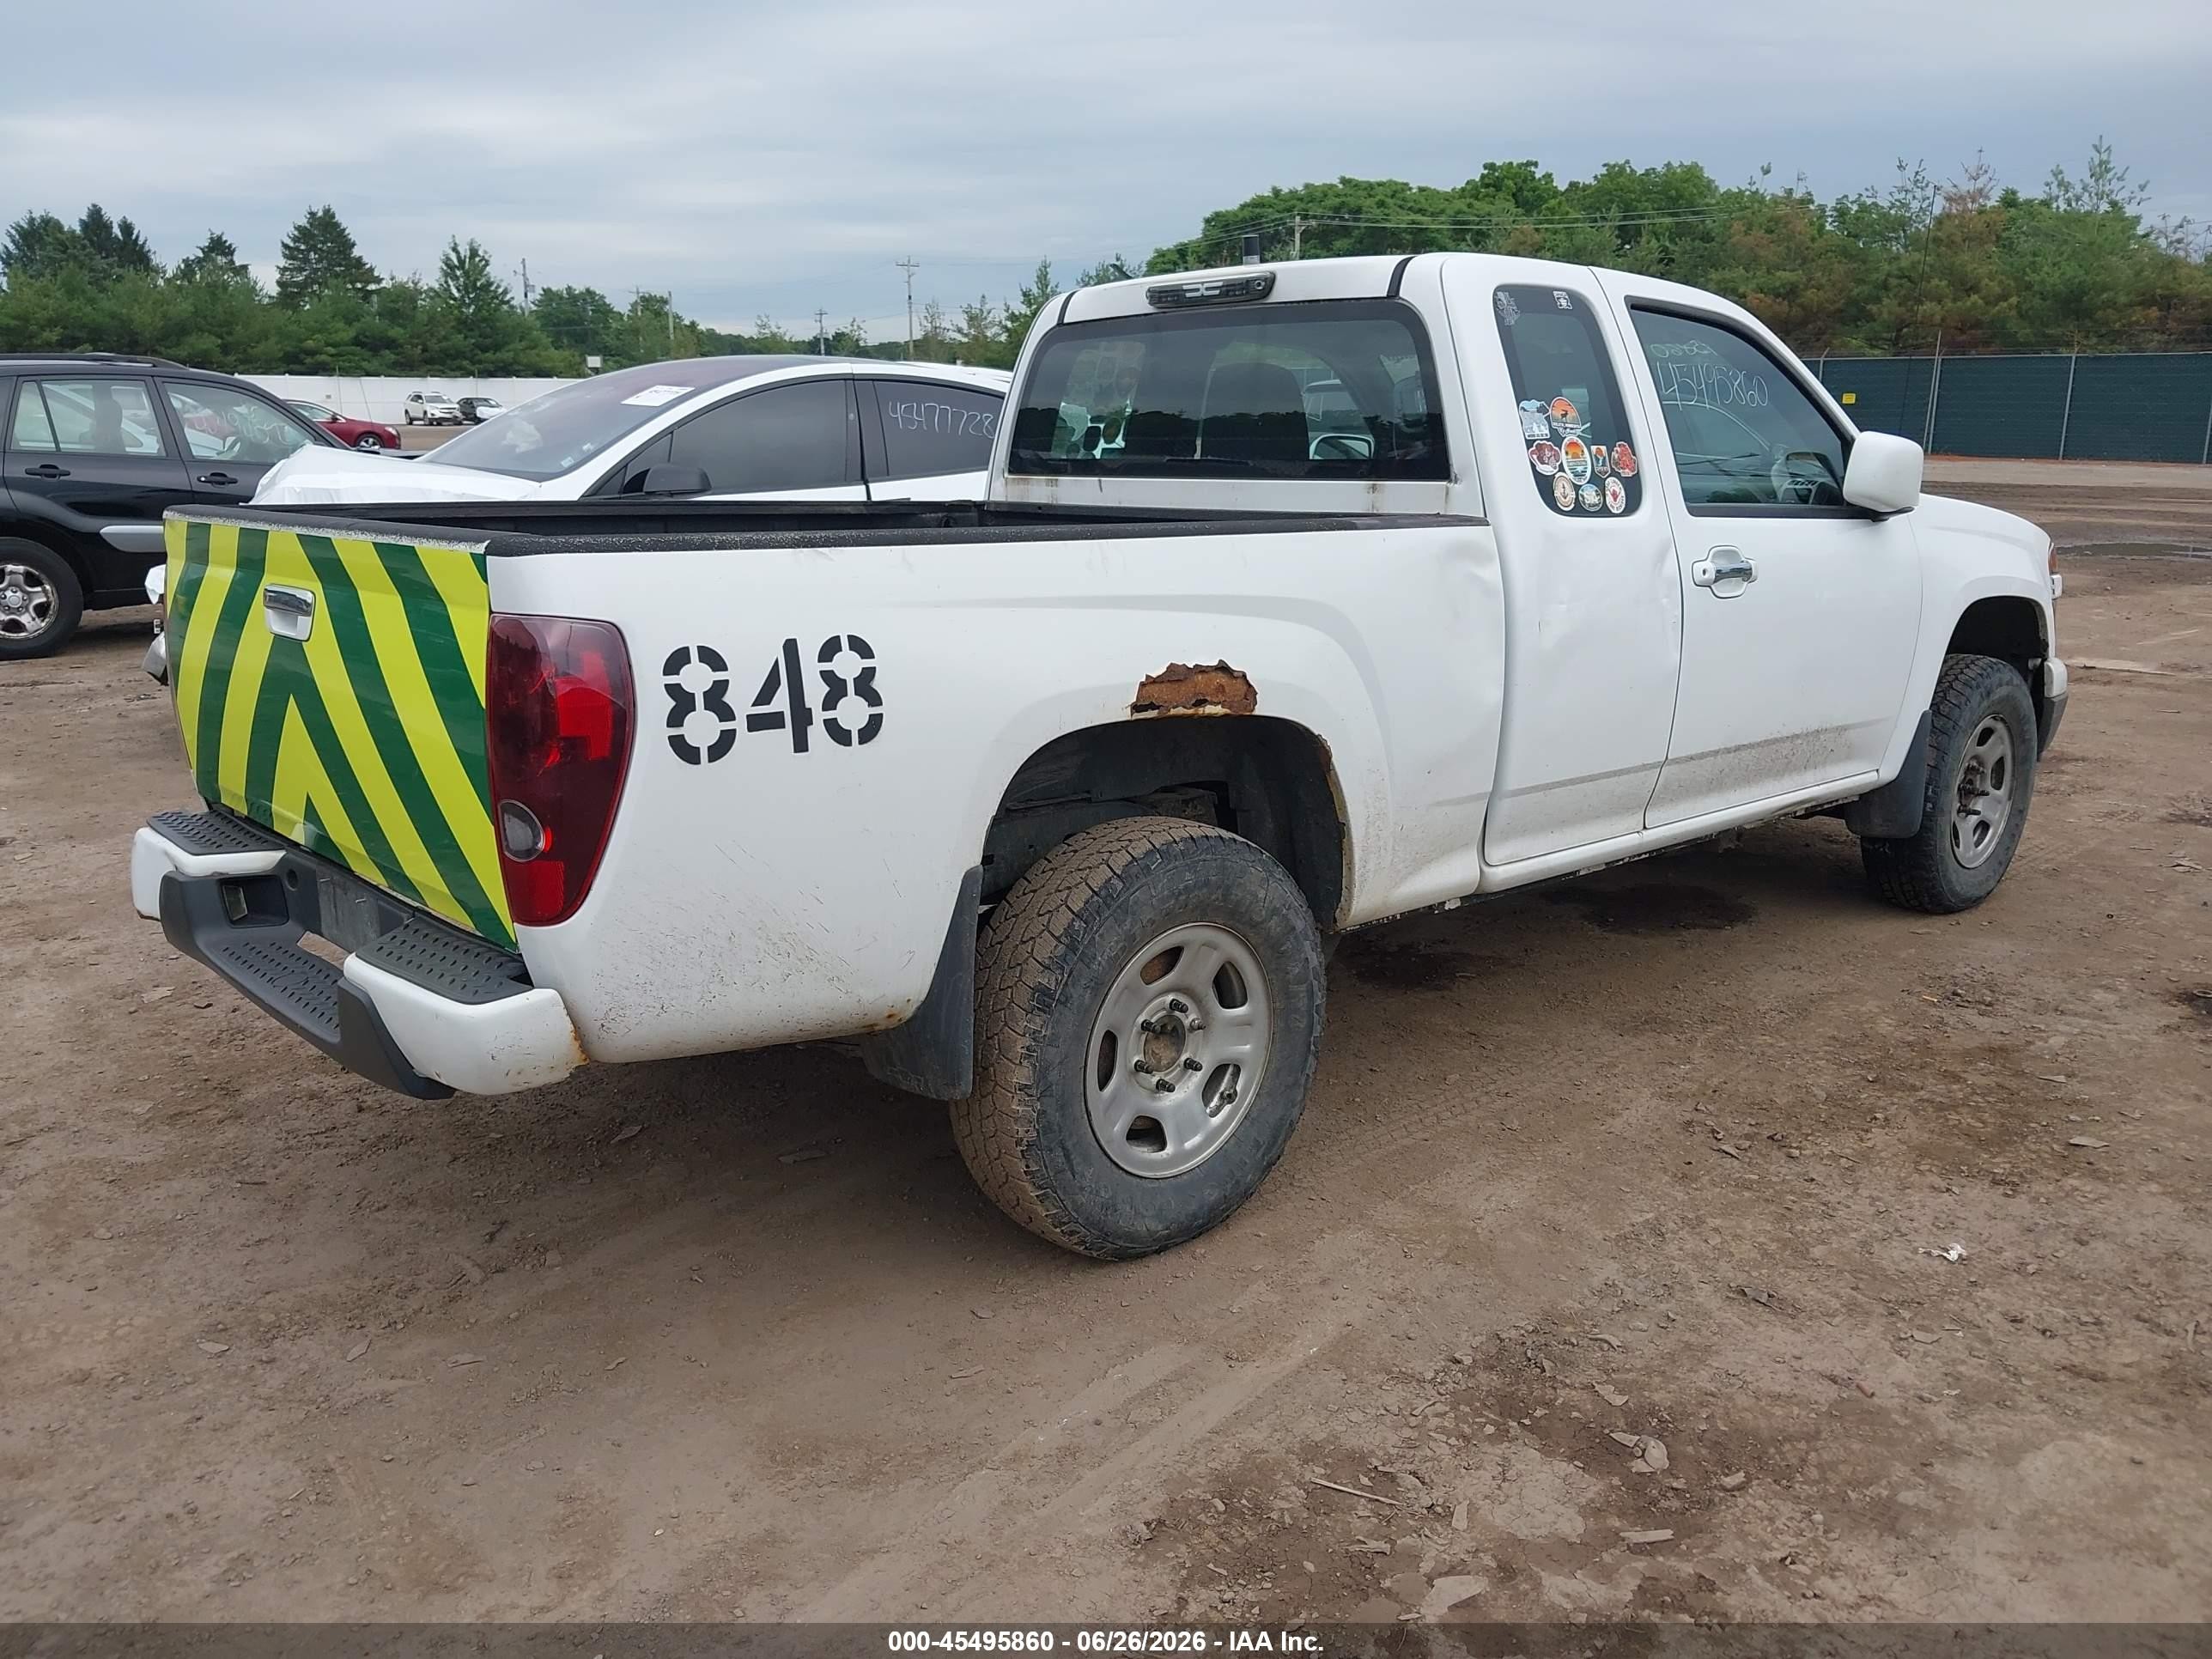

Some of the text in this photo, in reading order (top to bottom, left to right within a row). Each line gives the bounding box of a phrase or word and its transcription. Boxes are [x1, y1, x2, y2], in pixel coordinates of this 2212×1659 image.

[1656, 361, 1769, 411] 45495860
[888, 400, 995, 439] 45477728
[662, 634, 884, 765] 848
